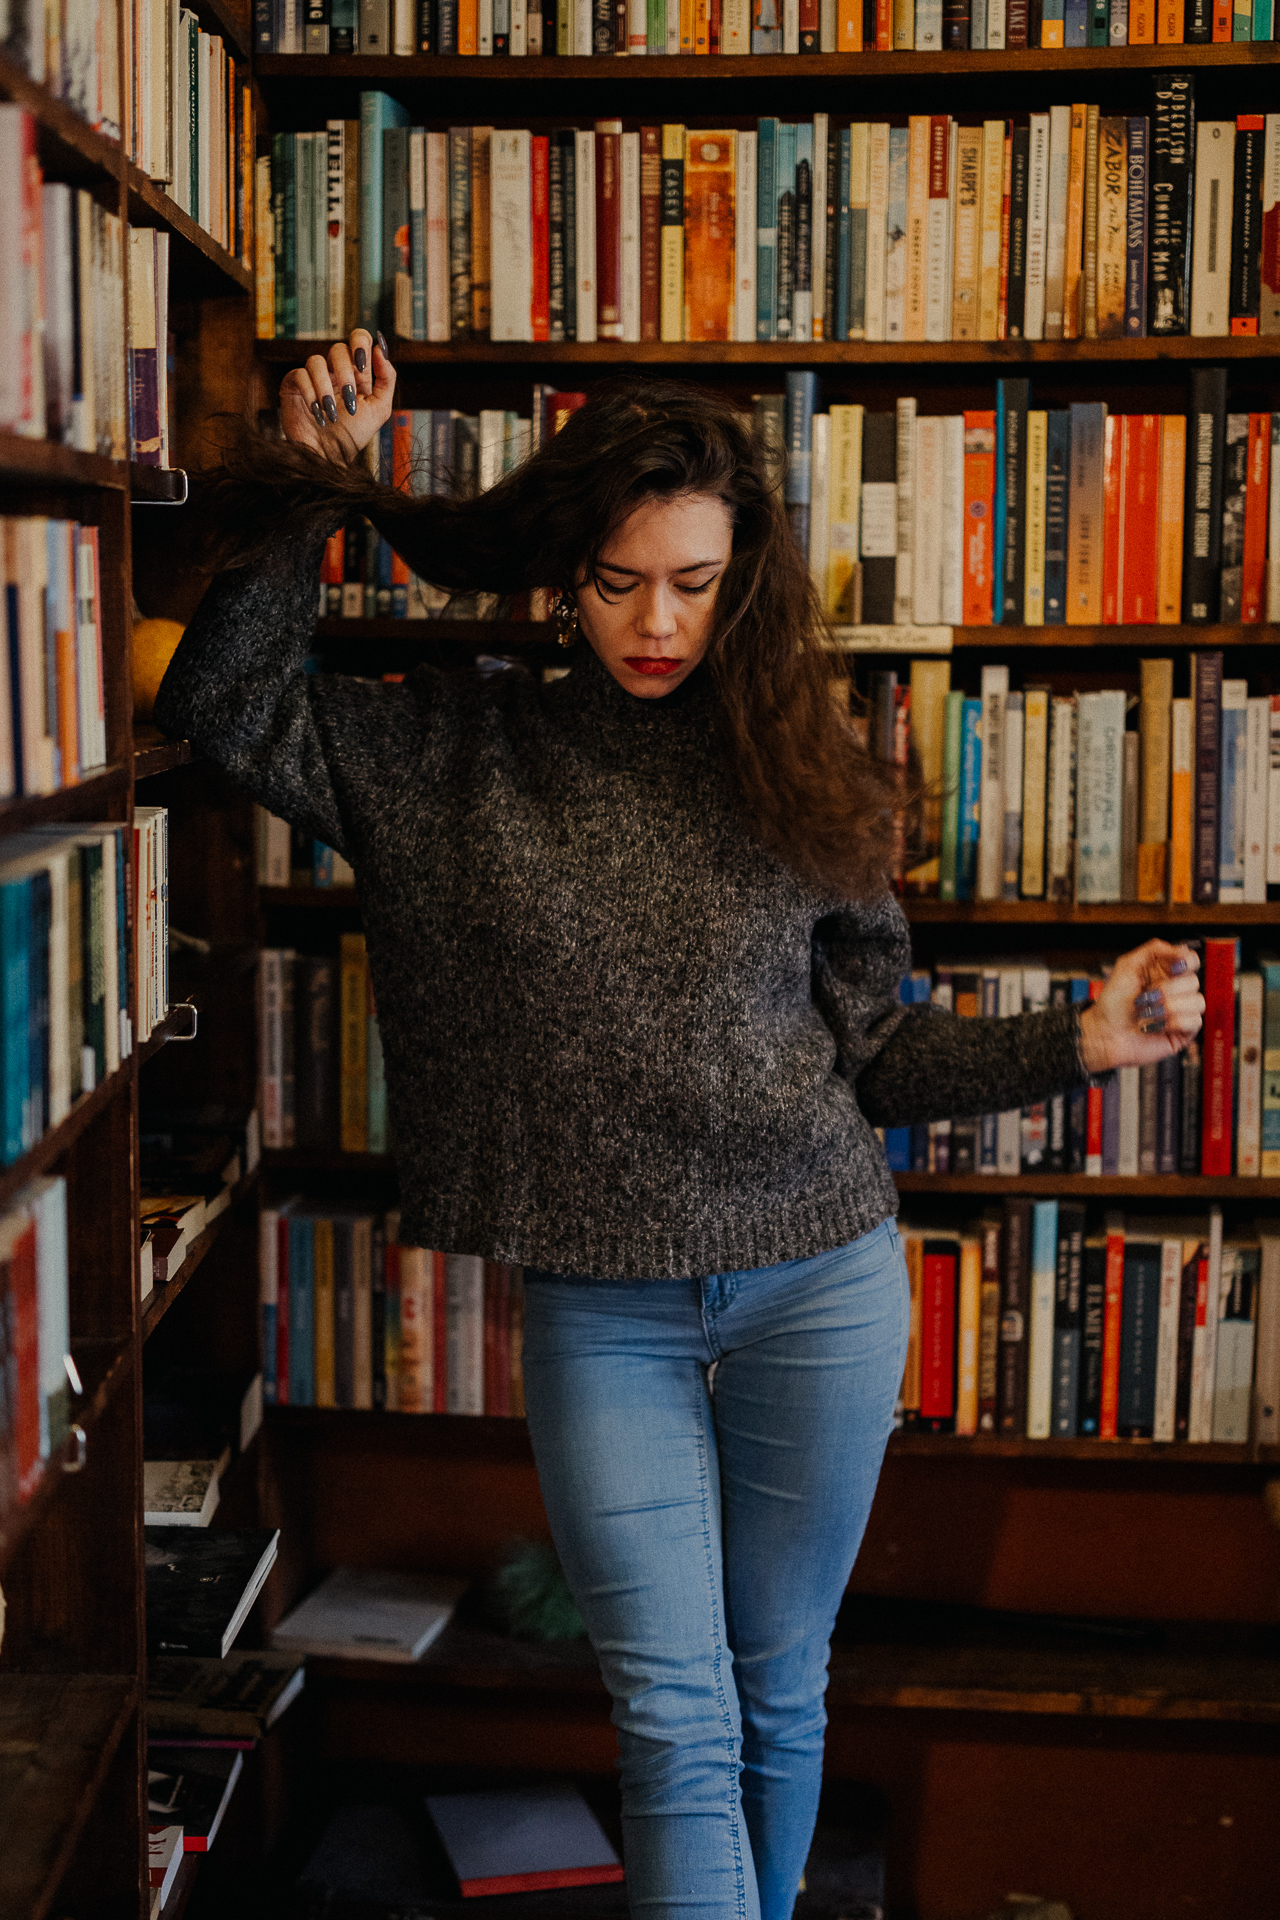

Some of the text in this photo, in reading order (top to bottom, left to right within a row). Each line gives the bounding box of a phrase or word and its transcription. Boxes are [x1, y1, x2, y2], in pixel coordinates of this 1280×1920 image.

[1154, 91, 1173, 155] DAVIES
[1169, 82, 1189, 165] ROBERTSON
[664, 168, 680, 217] CASEY
[959, 147, 978, 206] SHARPE'S
[1103, 130, 1125, 198] ZABOR
[1128, 131, 1145, 248] THE BOHEMIANS
[1152, 182, 1174, 246] CUNNING
[1170, 221, 1183, 245] THE
